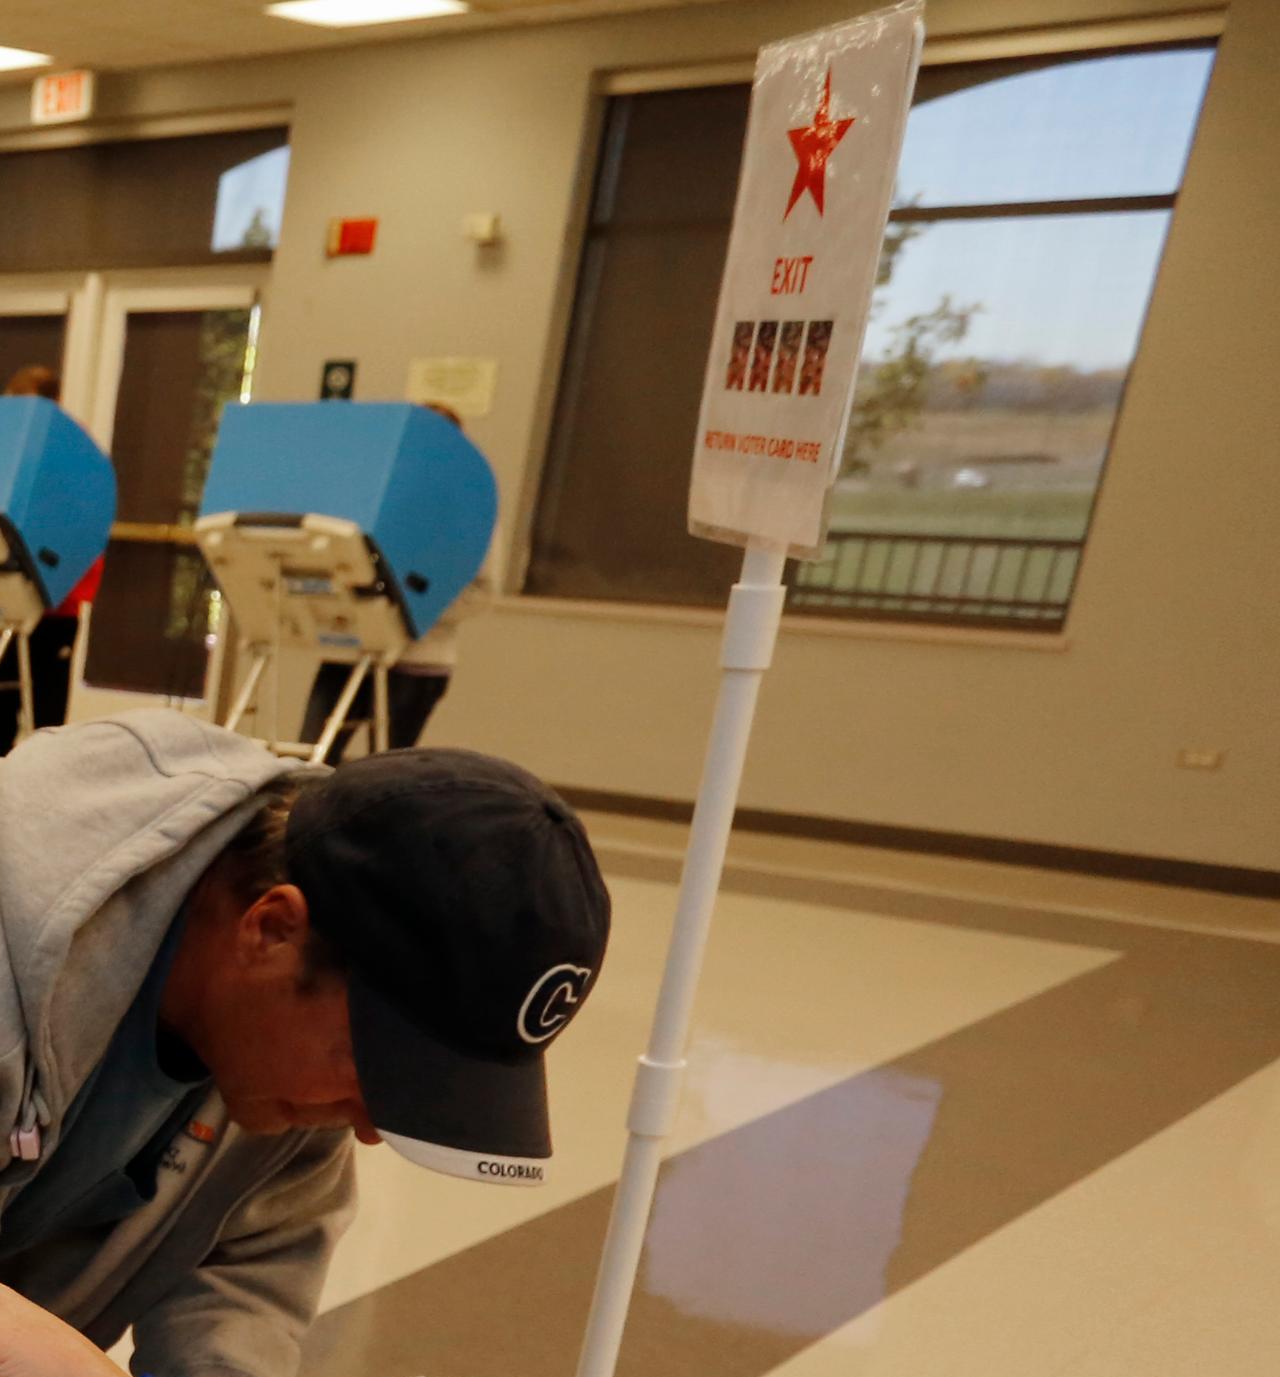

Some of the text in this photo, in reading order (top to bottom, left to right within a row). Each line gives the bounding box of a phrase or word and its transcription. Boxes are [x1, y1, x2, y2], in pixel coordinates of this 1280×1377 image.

[770, 255, 814, 295] EXIT
[704, 430, 822, 464] RETURN VOTER CARD HERE
[516, 963, 591, 1043] C
